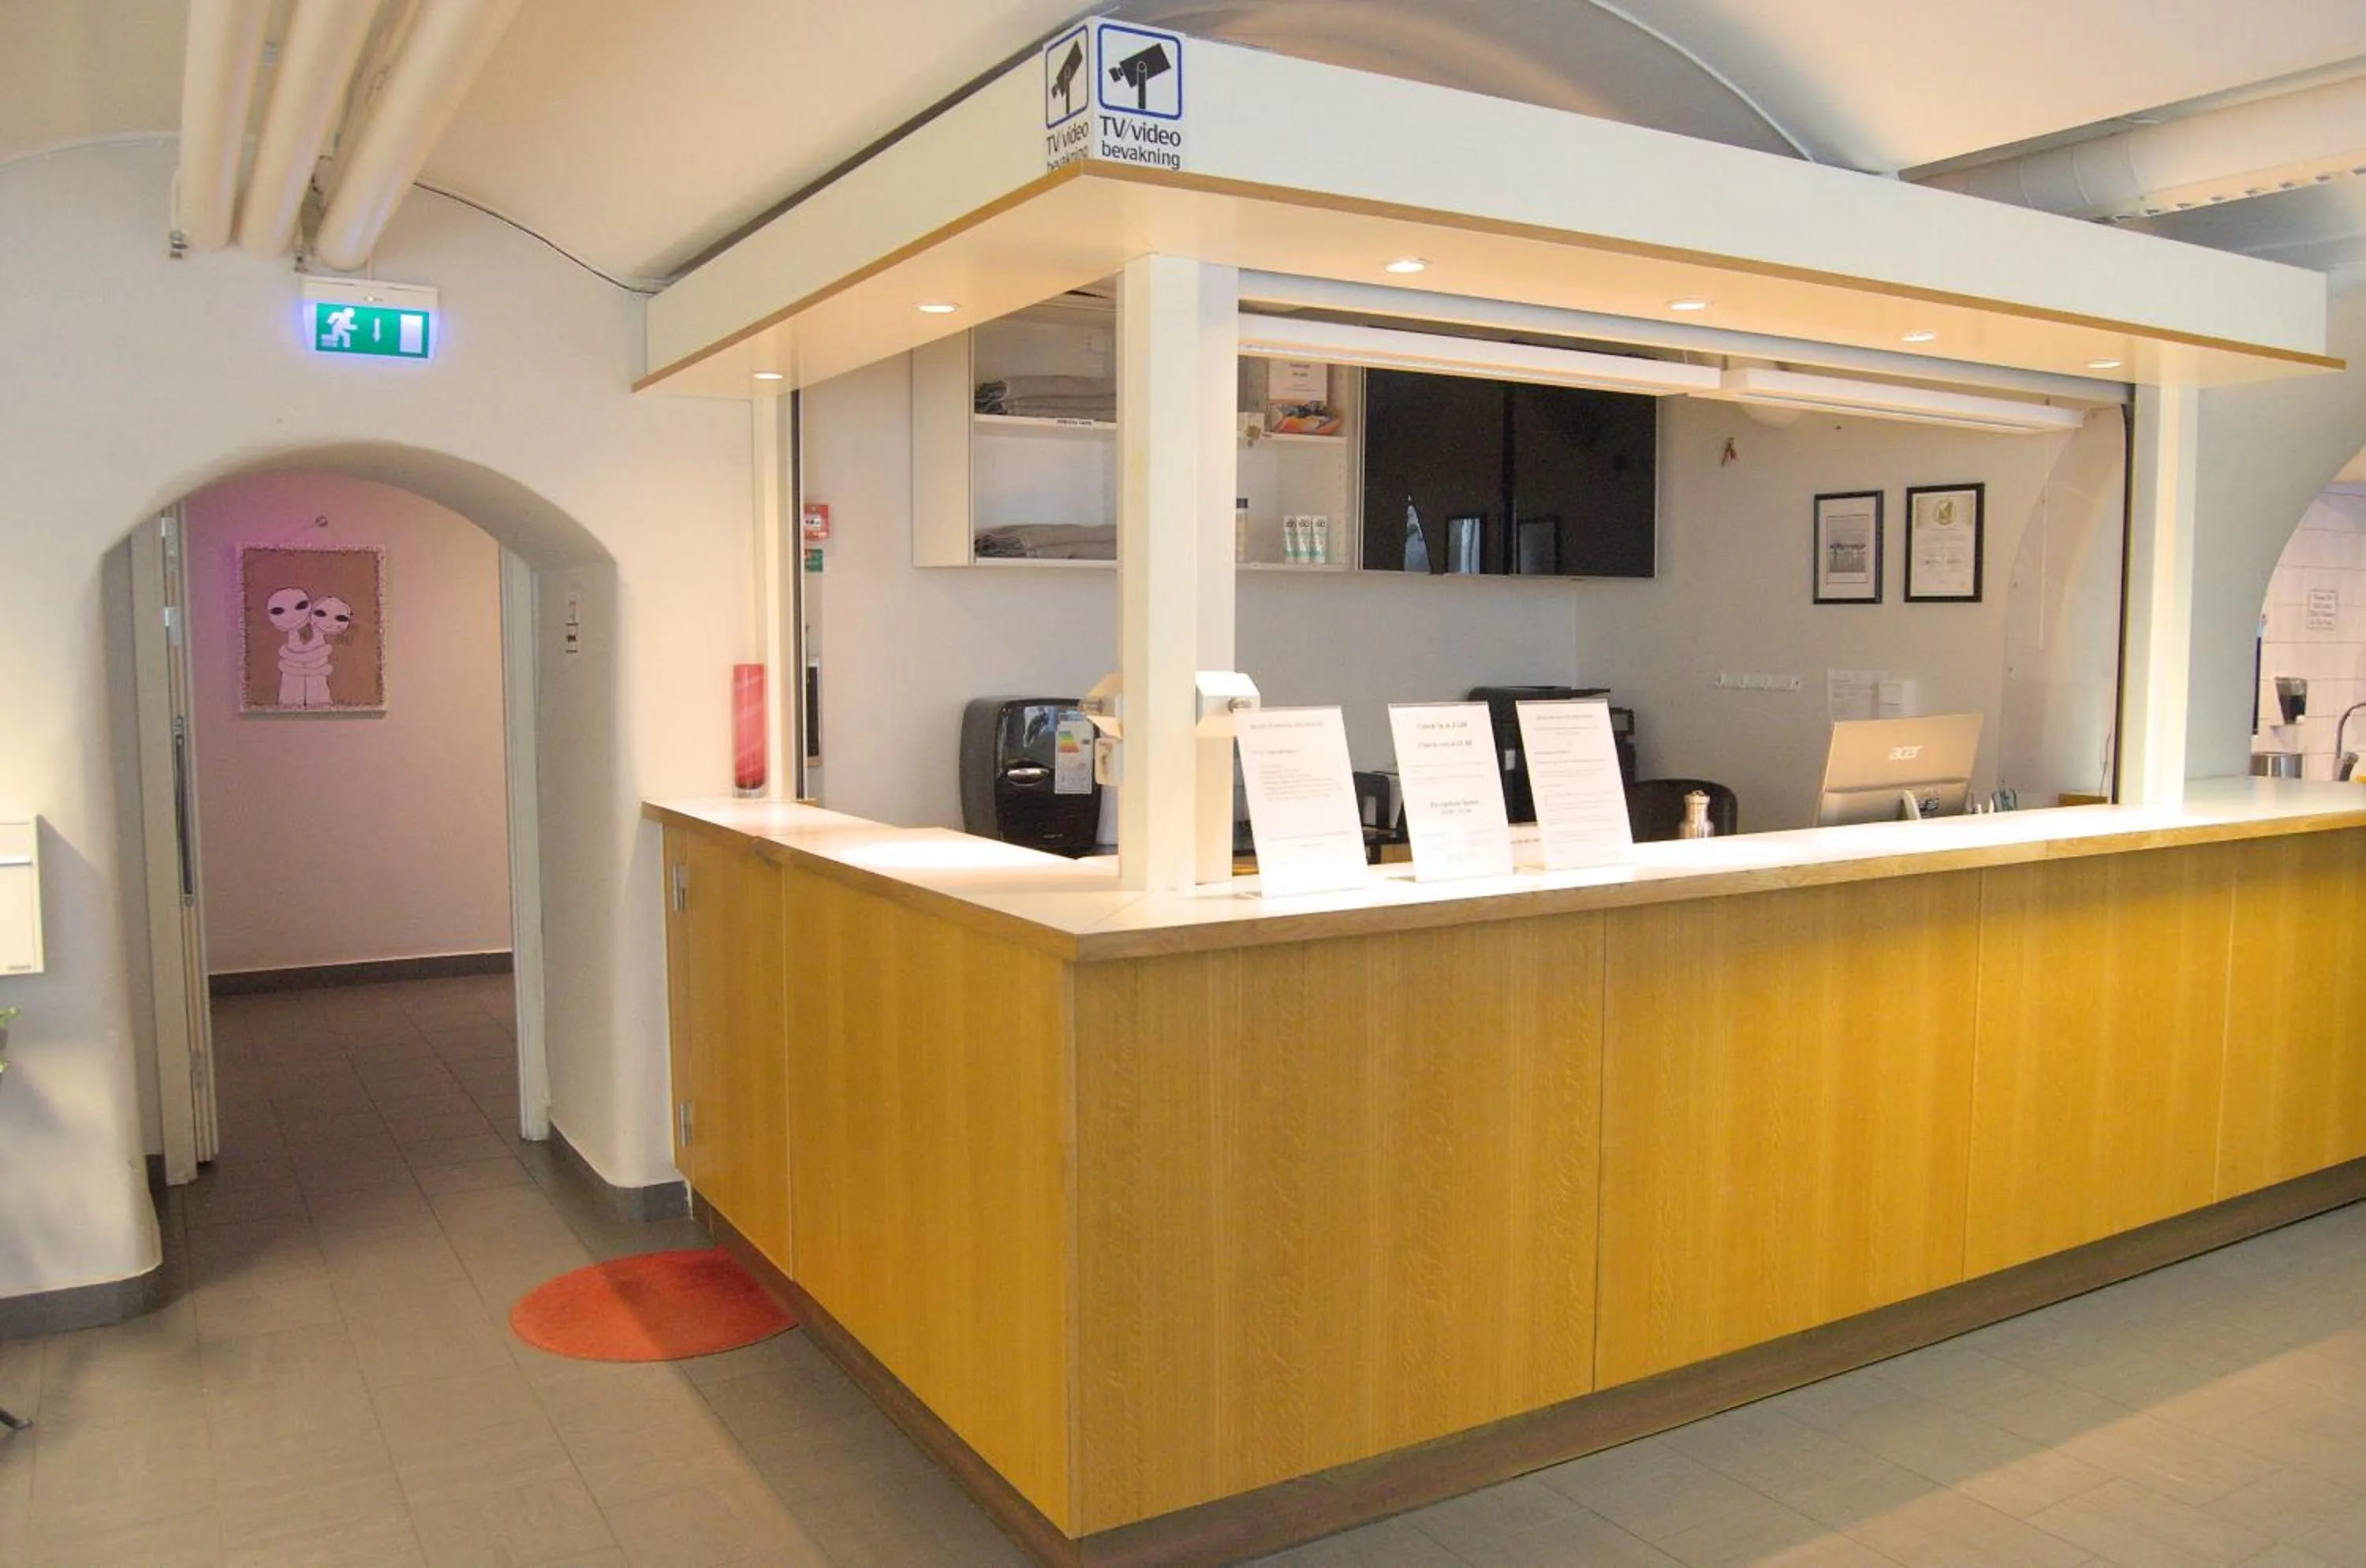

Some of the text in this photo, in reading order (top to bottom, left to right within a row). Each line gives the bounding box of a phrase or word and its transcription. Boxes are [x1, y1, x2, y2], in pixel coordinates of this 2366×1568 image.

[1047, 121, 1089, 156] TV/video
[1099, 115, 1181, 147] TV/video
[1102, 140, 1181, 170] bevakning
[1887, 745, 1924, 760] acer
